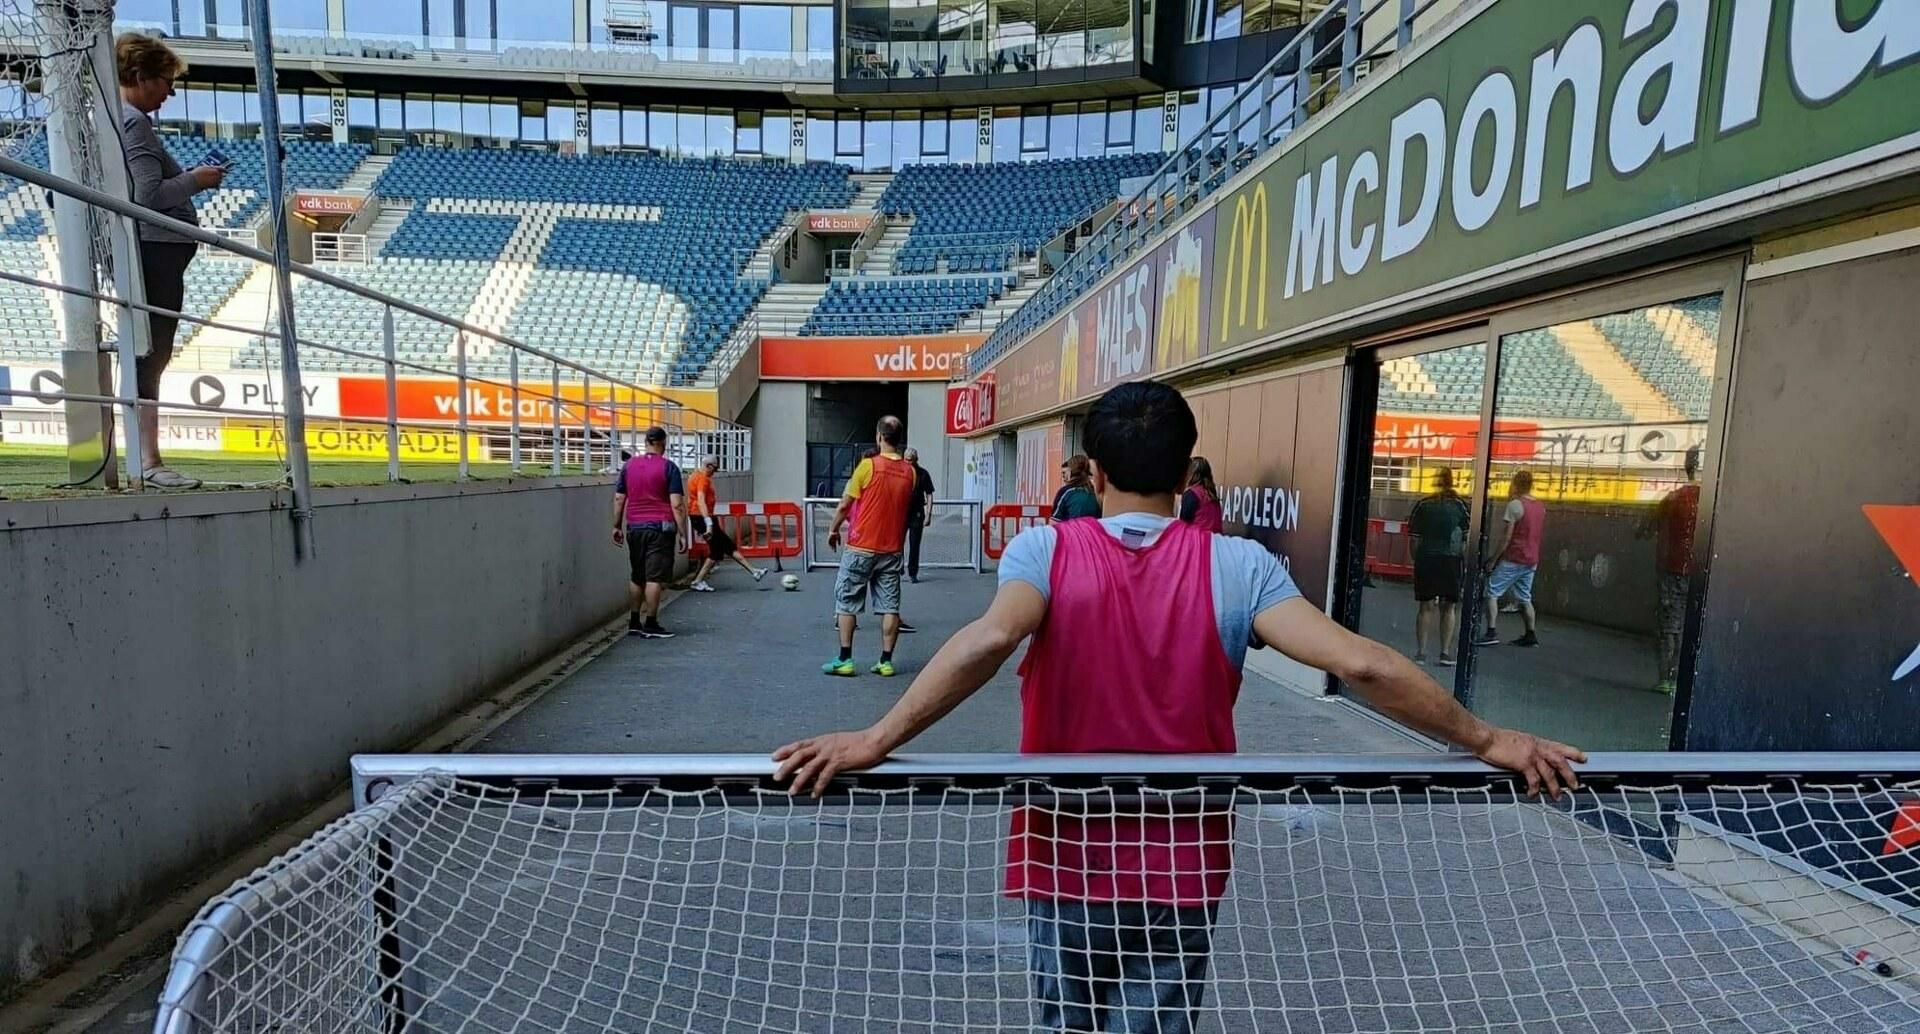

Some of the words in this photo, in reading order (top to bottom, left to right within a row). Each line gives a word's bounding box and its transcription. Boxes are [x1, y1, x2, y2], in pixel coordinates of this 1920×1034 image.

[334, 99, 345, 126] 322
[577, 111, 587, 137] 321
[1165, 103, 1176, 133] 229
[793, 120, 804, 147] 321
[980, 117, 990, 145] 229
[300, 197, 323, 209] vdk
[324, 199, 354, 210] bank
[810, 217, 831, 229] vdk
[832, 218, 860, 230] bank
[1094, 264, 1149, 387] MAES
[874, 345, 918, 371] vdk
[242, 383, 320, 407] PLY
[158, 425, 218, 441] ENTER
[246, 424, 458, 455] TAORMADE
